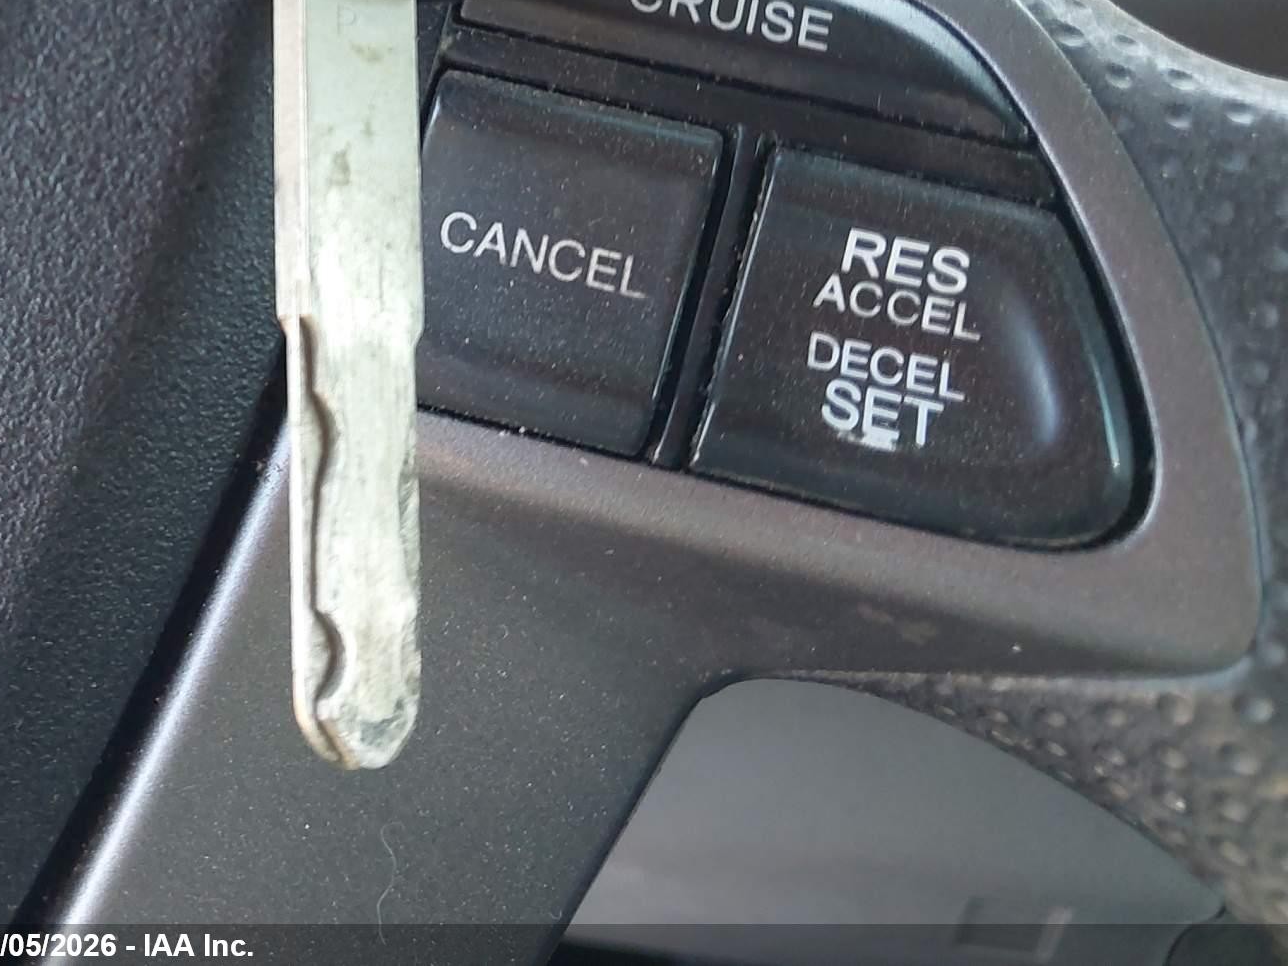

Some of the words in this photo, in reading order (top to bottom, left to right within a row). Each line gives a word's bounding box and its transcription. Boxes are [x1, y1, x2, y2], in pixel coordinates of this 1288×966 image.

[439, 211, 646, 299] CANCEL
[841, 228, 970, 294] RES
[813, 279, 980, 341] ACCEL
[807, 333, 965, 402] DECEL
[821, 380, 944, 448] SET
